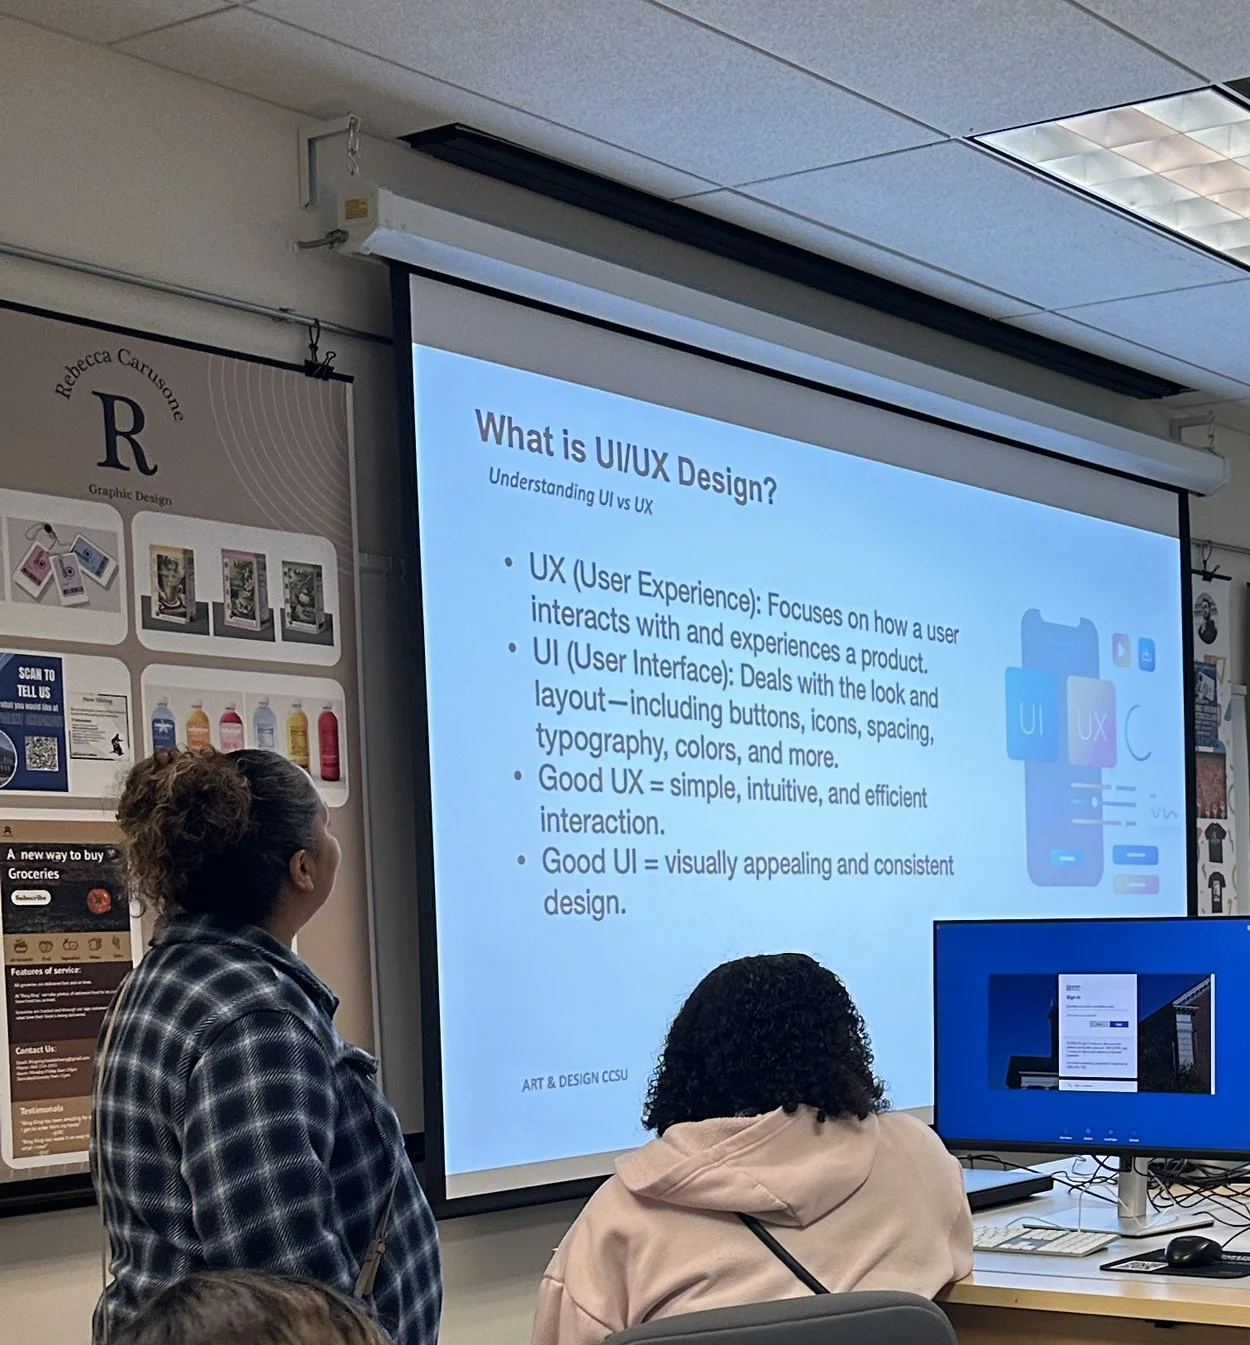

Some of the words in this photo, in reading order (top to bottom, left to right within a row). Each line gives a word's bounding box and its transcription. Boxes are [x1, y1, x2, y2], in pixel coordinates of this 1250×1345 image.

[55, 350, 112, 400] Rebecca
[118, 348, 184, 421] Carusone
[91, 390, 158, 476] R
[475, 409, 554, 457] What
[563, 429, 586, 463] is
[596, 436, 670, 482] UI/UX
[678, 456, 777, 506] Design?
[89, 483, 132, 500] Graphic
[135, 490, 172, 506] Design
[489, 467, 595, 507] Understanding
[599, 489, 613, 507] UI
[617, 496, 631, 510] vs
[635, 496, 653, 515] UX
[530, 552, 566, 584] UX
[573, 559, 631, 593] (User
[638, 570, 761, 619] Experience):
[768, 592, 843, 627] Focuses
[848, 611, 869, 631] on
[874, 609, 908, 637] how
[913, 622, 922, 639] a
[927, 624, 959, 644] user
[531, 594, 630, 634] interacts
[636, 612, 680, 641] with
[687, 622, 724, 647] and
[730, 630, 840, 662] experiences
[846, 647, 856, 665] a
[861, 648, 928, 674] product.
[18, 666, 42, 681] SCAN
[44, 669, 55, 681] TO
[533, 636, 558, 666] UI
[567, 640, 627, 675] (User
[633, 649, 733, 691] Interface):
[740, 663, 793, 692] Deals
[797, 672, 834, 697] with
[839, 676, 866, 700] the
[871, 678, 906, 705] look
[910, 687, 938, 709] and
[17, 684, 37, 698] TELL
[39, 686, 51, 699] US
[729, 694, 805, 735] buttons,
[811, 708, 861, 739] icons,
[867, 718, 934, 747] spacing,
[1020, 702, 1043, 736] UI
[1077, 710, 1108, 743] UX
[536, 723, 668, 763] typography,
[675, 734, 741, 766] colors,
[748, 740, 783, 765] and
[789, 748, 838, 768] more.
[539, 763, 603, 793] Good
[611, 767, 644, 795] UX
[650, 780, 664, 792] =
[670, 772, 741, 804] simple,
[747, 776, 822, 807] intuitive,
[828, 782, 860, 805] and
[865, 784, 928, 808] efficient
[541, 805, 665, 835] interaction.
[7, 848, 15, 860] A
[21, 850, 44, 860] new
[45, 851, 67, 862] way
[70, 850, 81, 860] to
[84, 849, 104, 862] buy
[542, 847, 605, 874] Good
[614, 848, 636, 874] UI
[644, 859, 659, 870] =
[665, 848, 738, 881] visually
[744, 851, 832, 881] appealing
[837, 852, 869, 875] and
[874, 853, 954, 875] consistent
[8, 868, 60, 879] Groceries
[544, 888, 626, 921] design.
[10, 968, 43, 976] Features
[44, 966, 53, 975] of
[15, 1046, 43, 1055] Contact
[522, 1077, 544, 1092] ART
[547, 1076, 556, 1089] &
[559, 1072, 599, 1087] DESIGN
[602, 1069, 628, 1083] CCSU
